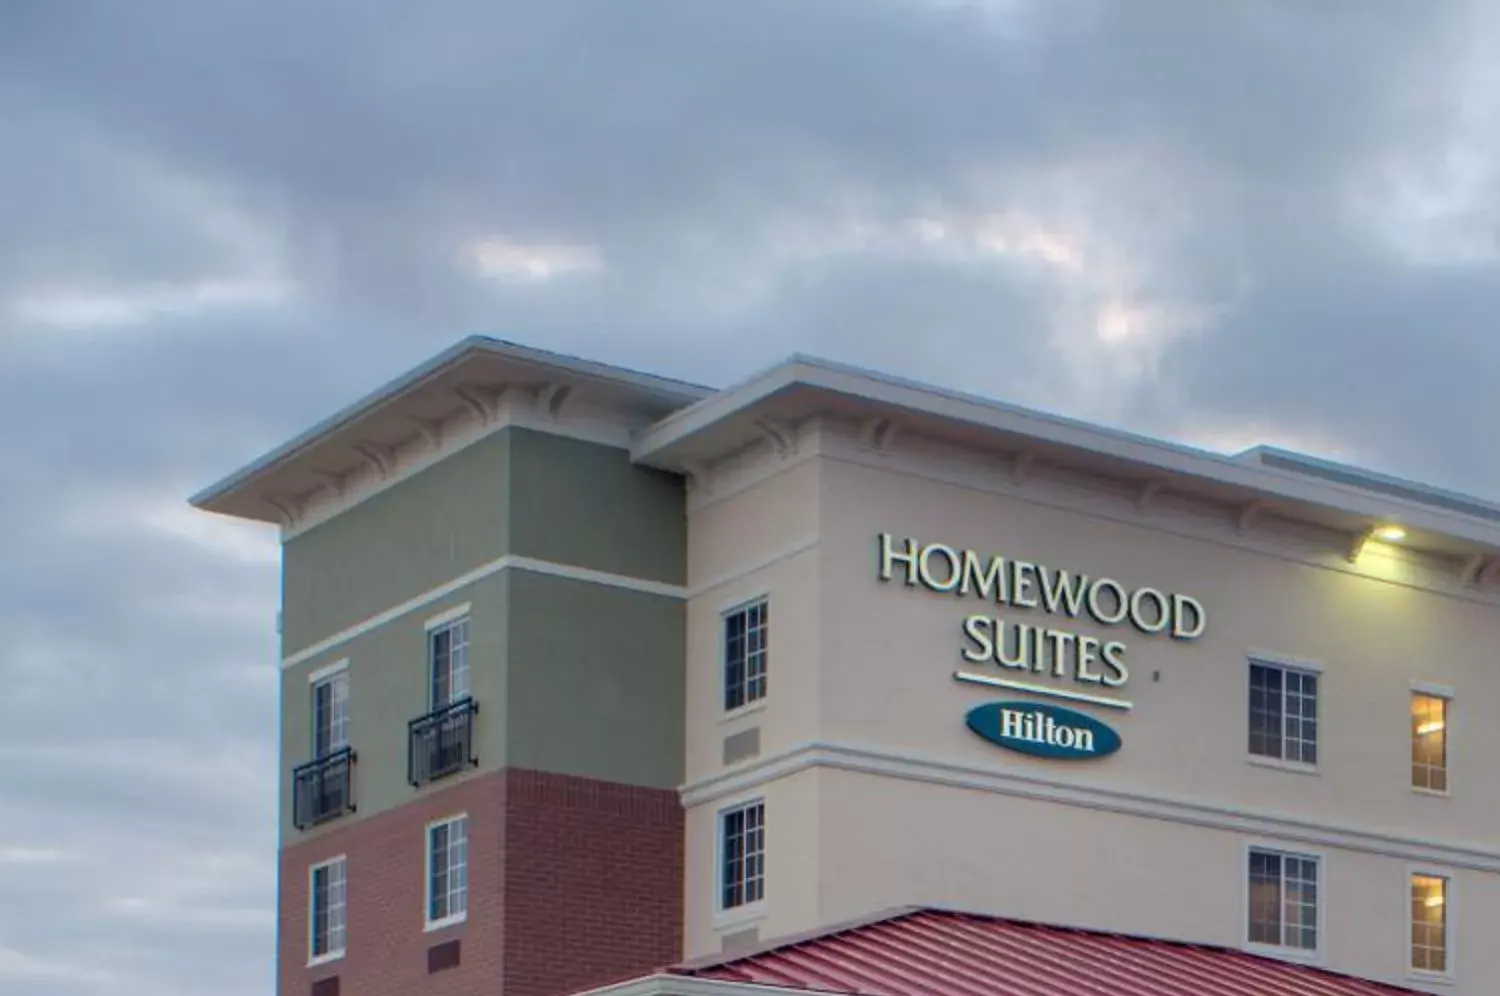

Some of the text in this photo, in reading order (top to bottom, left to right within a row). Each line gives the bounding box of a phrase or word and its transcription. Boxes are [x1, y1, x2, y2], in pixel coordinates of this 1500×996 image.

[879, 532, 1207, 640] HOMEWOOD
[962, 614, 1129, 687] SUITES
[1000, 708, 1095, 752] Hilton
